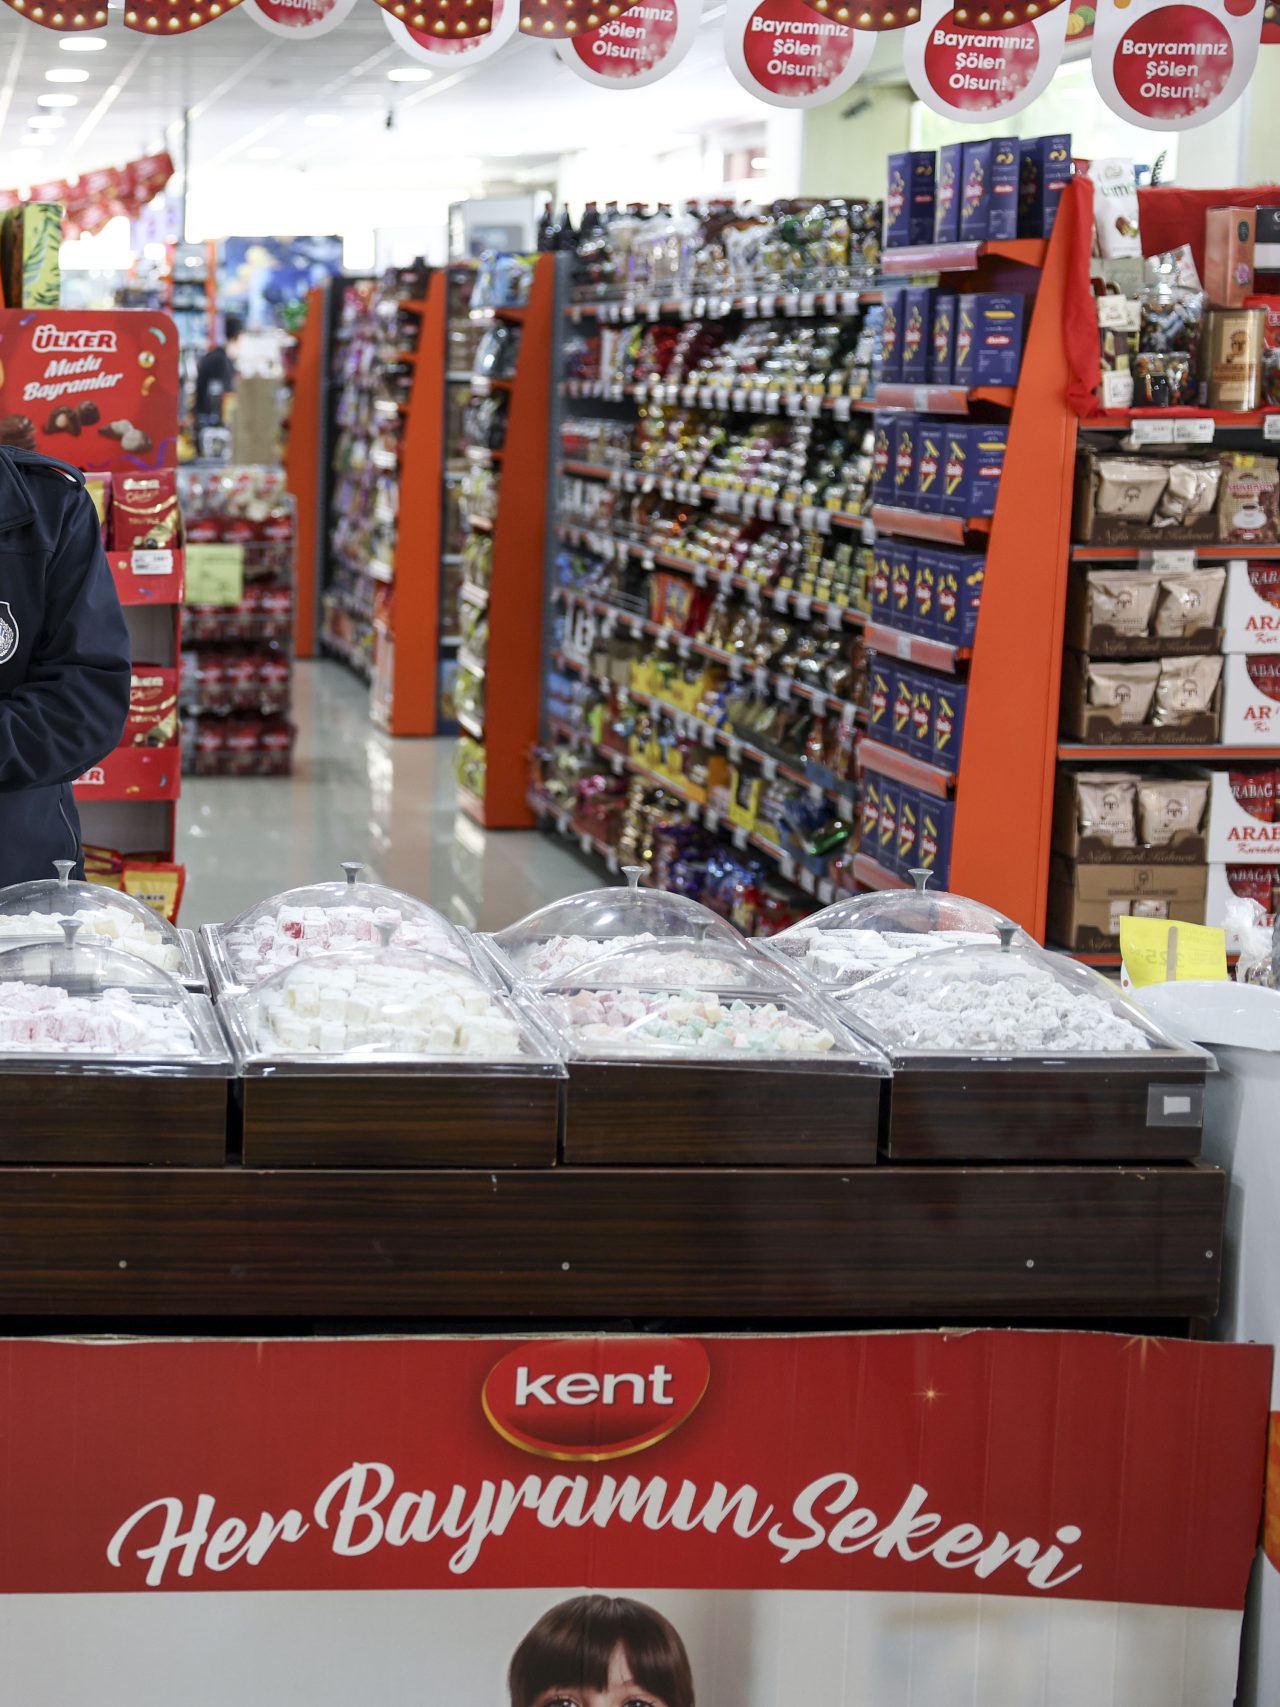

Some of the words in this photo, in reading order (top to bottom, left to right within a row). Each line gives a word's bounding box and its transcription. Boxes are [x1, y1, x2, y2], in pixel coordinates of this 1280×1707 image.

[598, 22, 647, 40] Şölen
[751, 15, 849, 38] Bayramınız
[592, 40, 648, 60] Olsun!
[772, 37, 822, 58] Şölen
[932, 29, 1035, 51] Bayramınız
[1122, 39, 1228, 59] Bayramınız
[767, 59, 823, 77] Olsun!
[955, 52, 1006, 72] Şölen
[1145, 60, 1199, 80] Şölen
[949, 73, 1007, 92] Olsun!
[1140, 82, 1200, 99] Olsun!
[33, 324, 117, 352] ÜLKER
[43, 354, 103, 379] Mutlu
[23, 372, 124, 401] Bayramlar
[514, 1364, 674, 1406] kent
[106, 1494, 309, 1587] Her
[313, 1462, 774, 1575] Bayramın
[768, 1472, 1083, 1589] Şekeri
